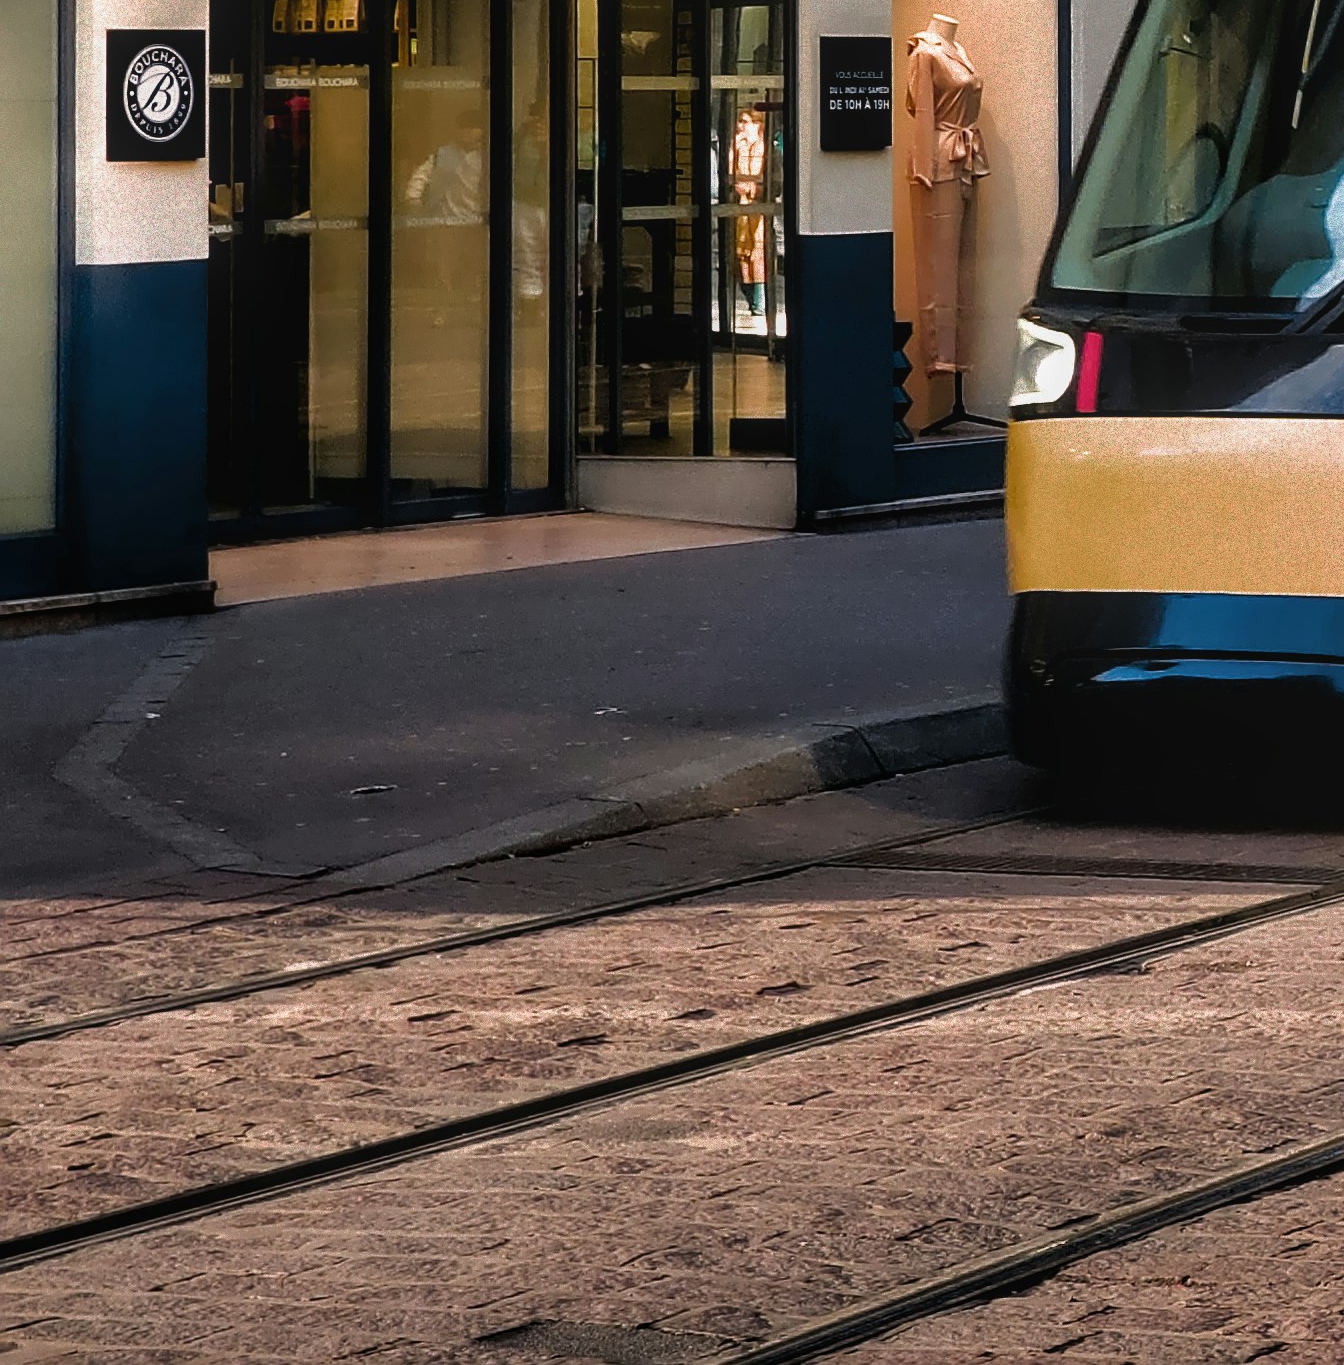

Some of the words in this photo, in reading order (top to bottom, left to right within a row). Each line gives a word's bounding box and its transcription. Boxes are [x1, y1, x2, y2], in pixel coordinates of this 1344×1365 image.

[129, 51, 189, 87] BOUCHARA
[839, 86, 858, 94] LNDI
[829, 99, 843, 110] DE
[844, 99, 862, 110] 10H
[864, 96, 871, 110] À
[873, 99, 890, 110] 19H
